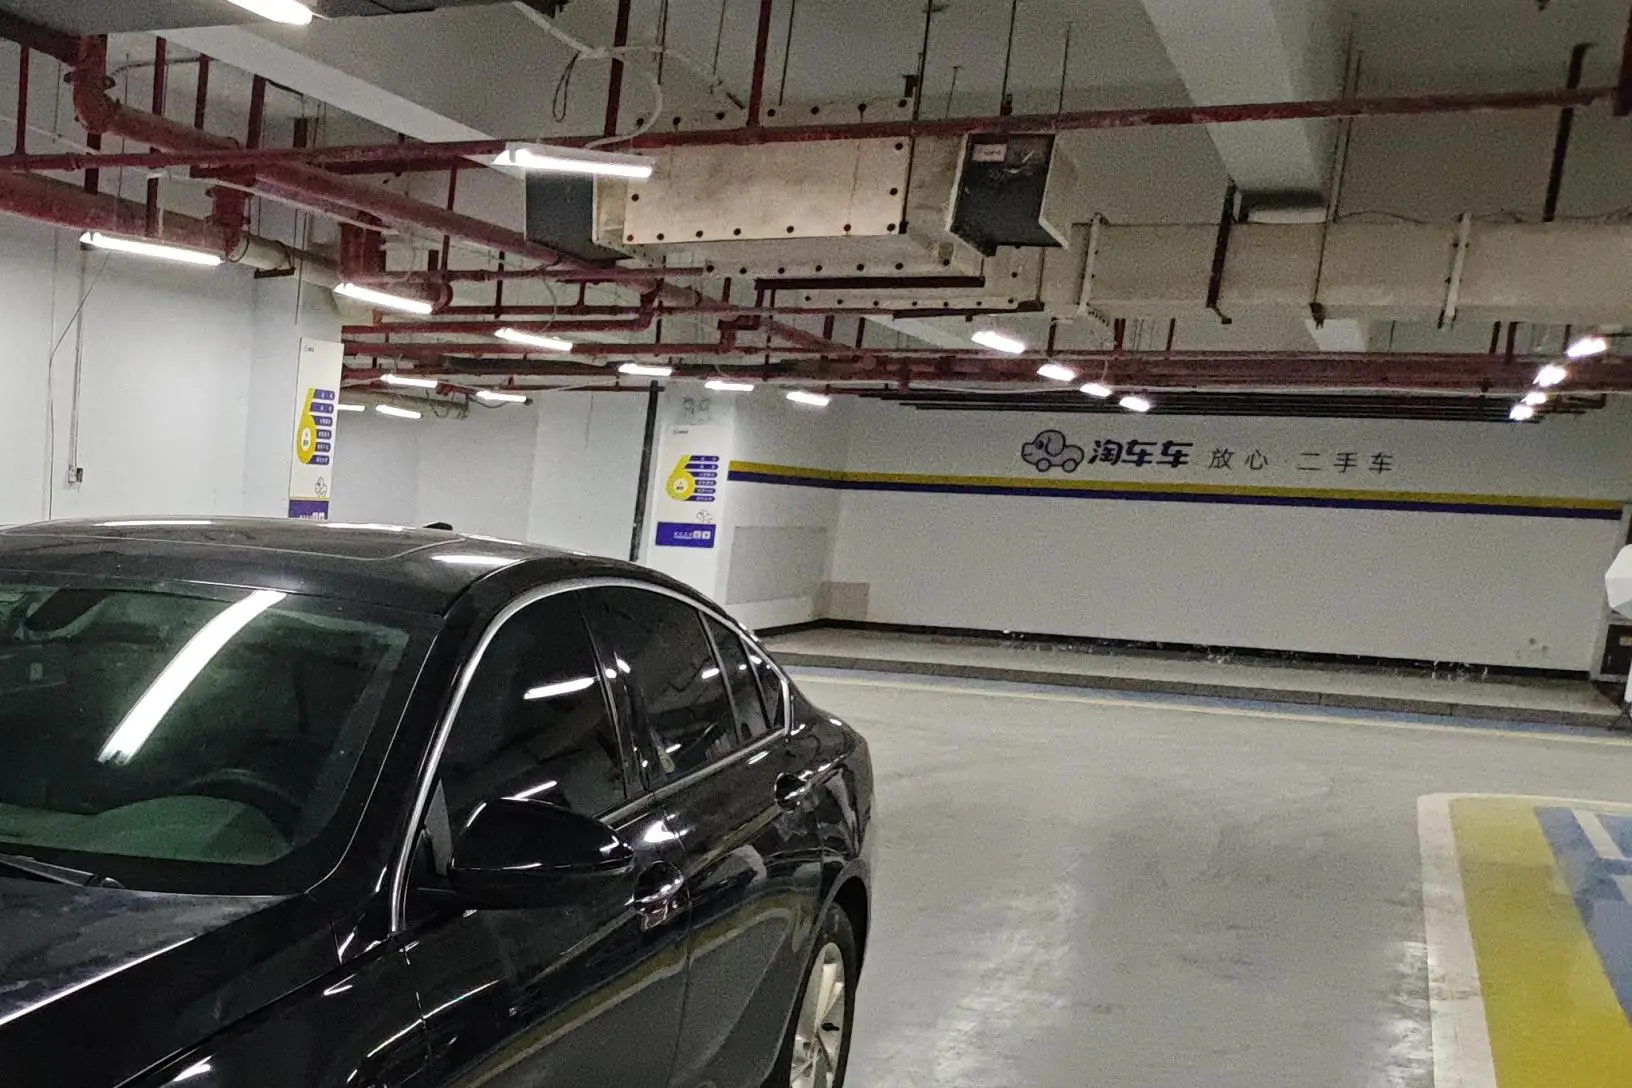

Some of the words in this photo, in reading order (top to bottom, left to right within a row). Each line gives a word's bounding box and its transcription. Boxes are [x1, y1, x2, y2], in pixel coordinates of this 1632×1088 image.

[1087, 439, 1194, 468] 淘车车
[1208, 448, 1270, 470] 放心
[1296, 451, 1394, 475] 二手车
